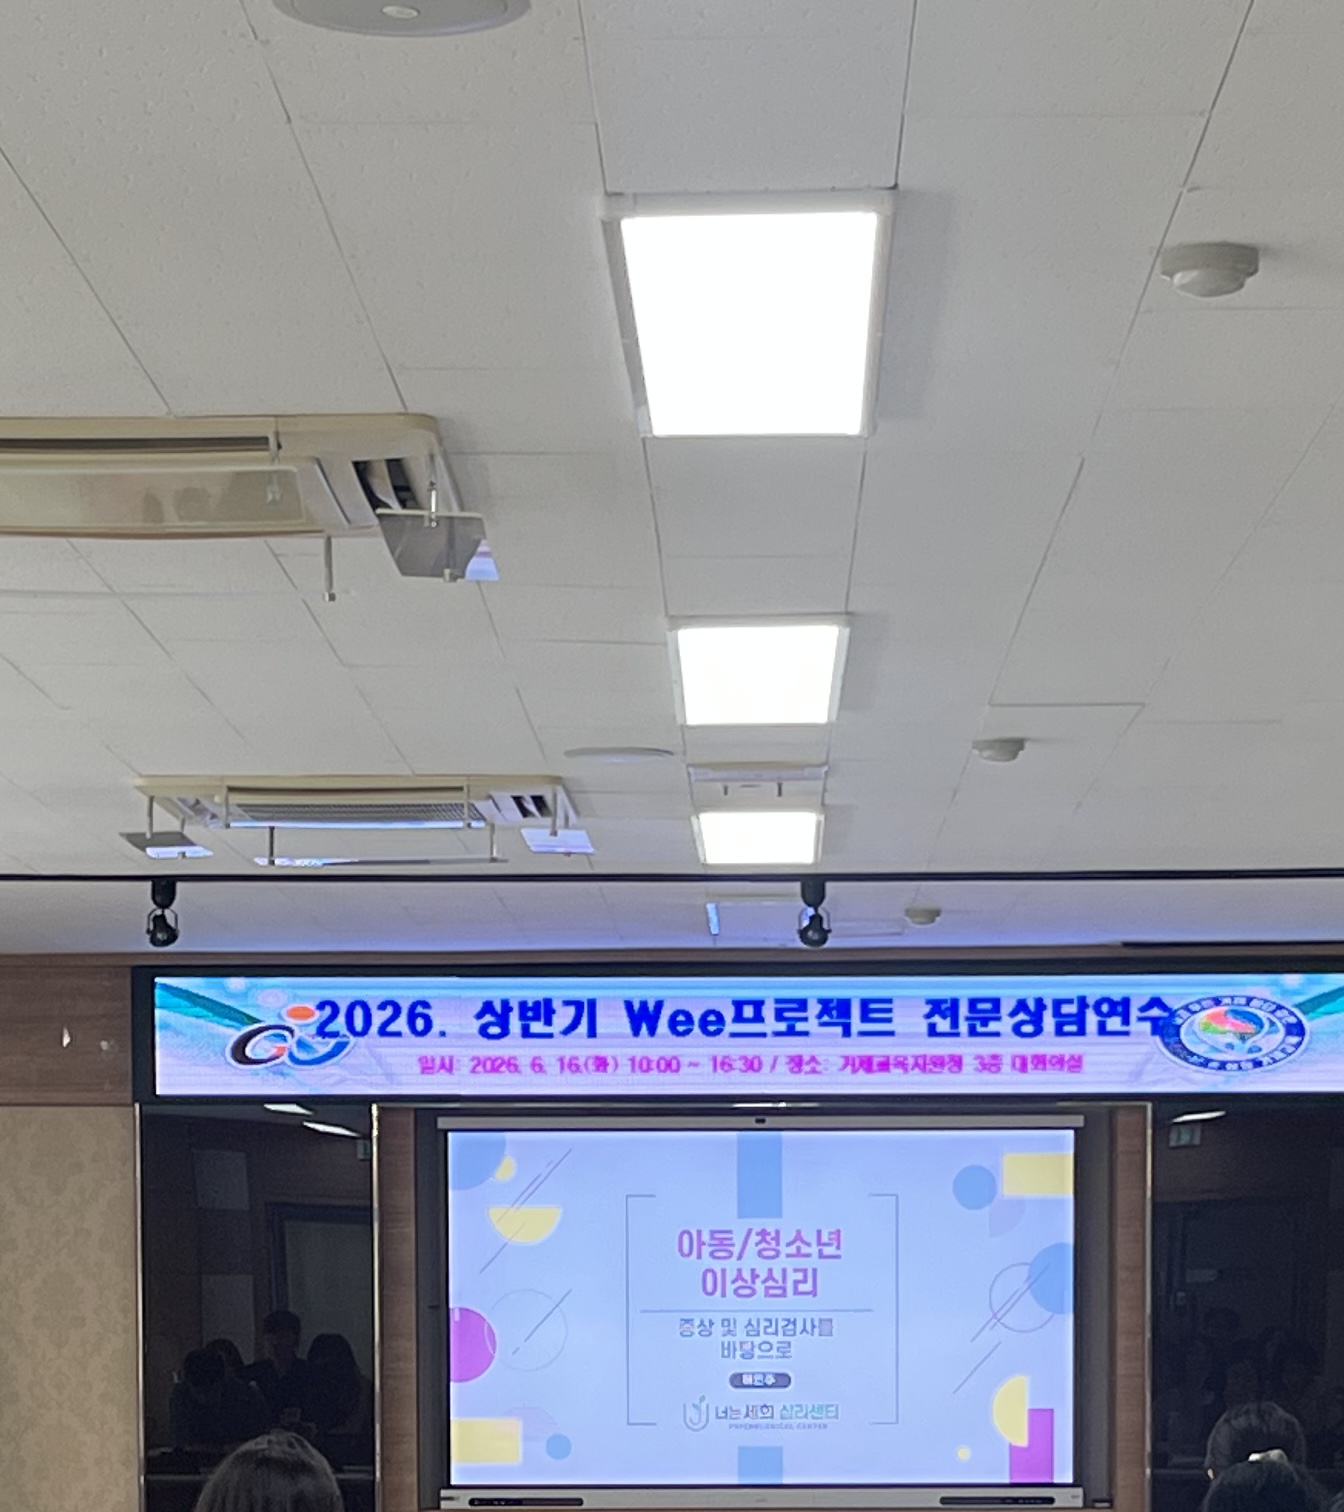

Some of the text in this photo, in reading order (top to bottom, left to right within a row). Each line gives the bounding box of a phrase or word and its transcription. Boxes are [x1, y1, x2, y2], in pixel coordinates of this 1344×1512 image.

[315, 1000, 447, 1039] 2026.
[474, 998, 597, 1040] 상반기
[624, 998, 895, 1038] Wee프로젝트
[923, 995, 1175, 1038] 전문상담연수
[628, 1055, 681, 1074] 10:00
[711, 1055, 763, 1074] 16:30
[769, 1056, 778, 1073] /
[677, 1228, 842, 1261] 아동/청소년
[701, 1267, 818, 1298] 이상심리
[679, 1317, 834, 1337] 증상 및 심리검사를
[720, 1340, 793, 1360] 바탕으로
